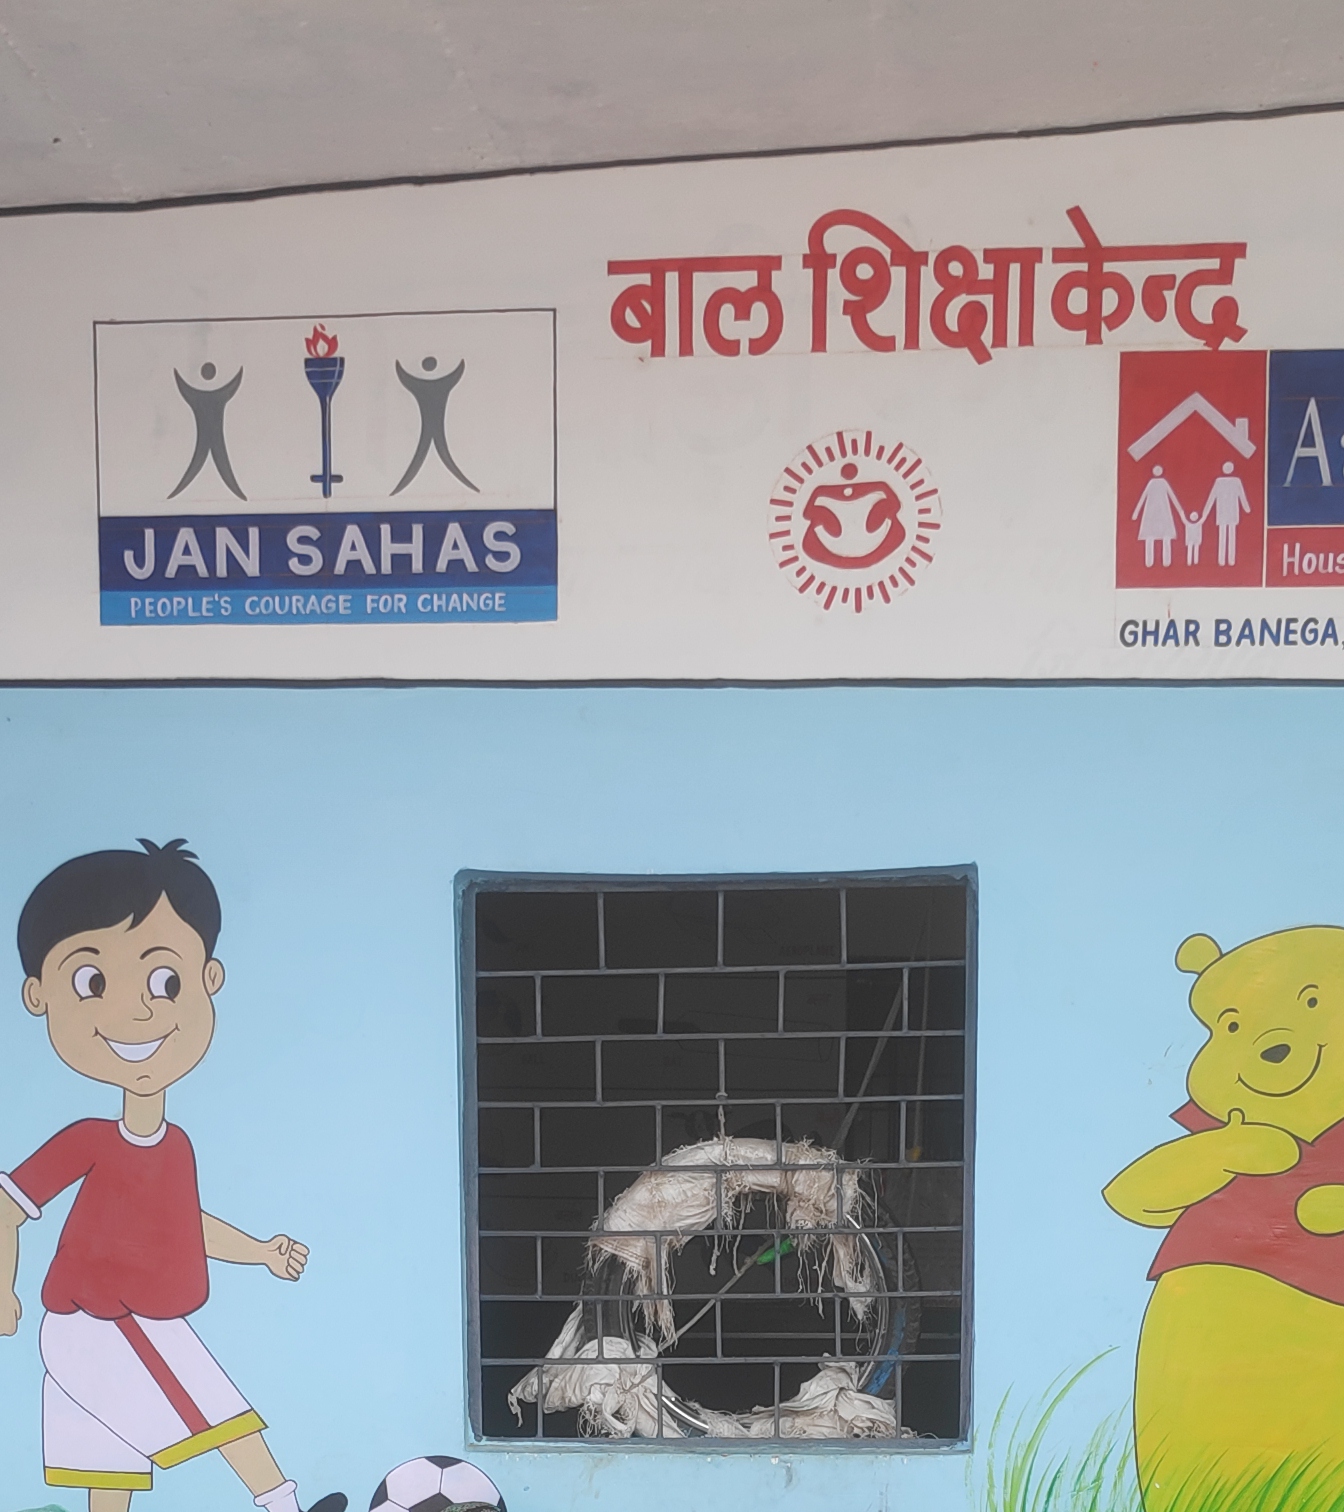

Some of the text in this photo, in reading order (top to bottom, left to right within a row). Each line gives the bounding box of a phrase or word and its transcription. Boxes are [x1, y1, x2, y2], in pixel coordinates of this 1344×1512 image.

[607, 255, 784, 358] बाल
[801, 208, 1044, 366] शिक्षा
[123, 520, 521, 580] JAN SAHAS
[130, 592, 506, 618] PEOPLE'S COURAGE FOR CHANGE
[1119, 618, 1201, 648] GHAR
